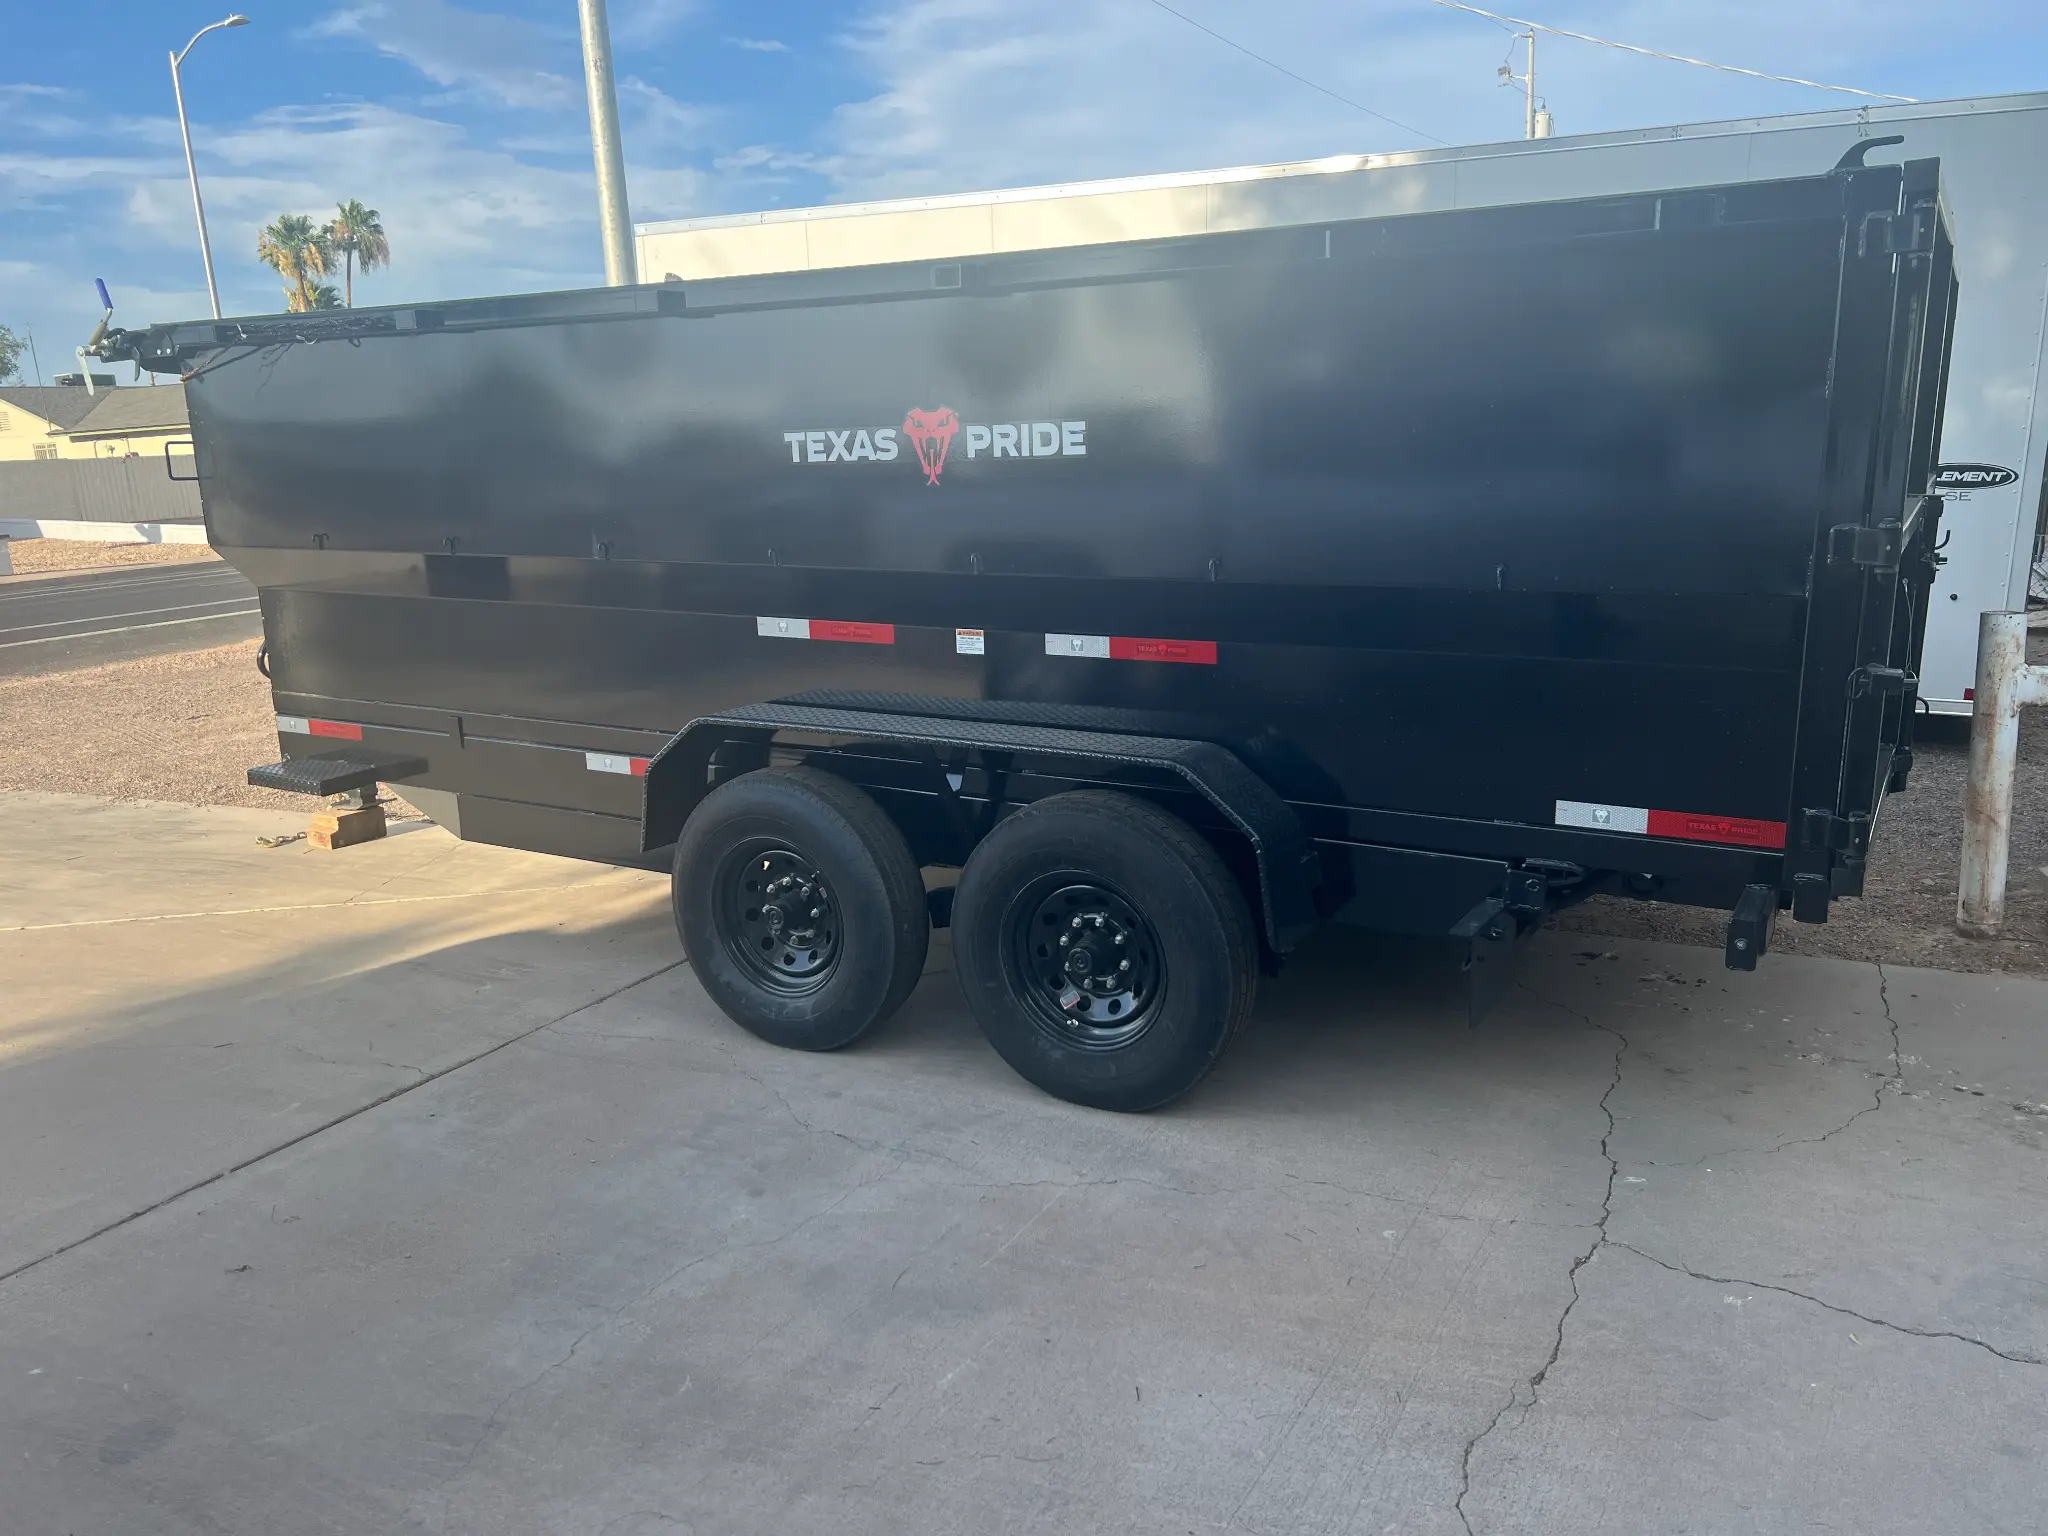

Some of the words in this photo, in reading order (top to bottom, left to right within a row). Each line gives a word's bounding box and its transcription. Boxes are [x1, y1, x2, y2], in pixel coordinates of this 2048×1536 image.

[784, 428, 899, 463] TEXAS
[965, 420, 1087, 458] PRIDE
[1689, 822, 1717, 831] TEXAS
[1731, 826, 1758, 835] PRIDE
